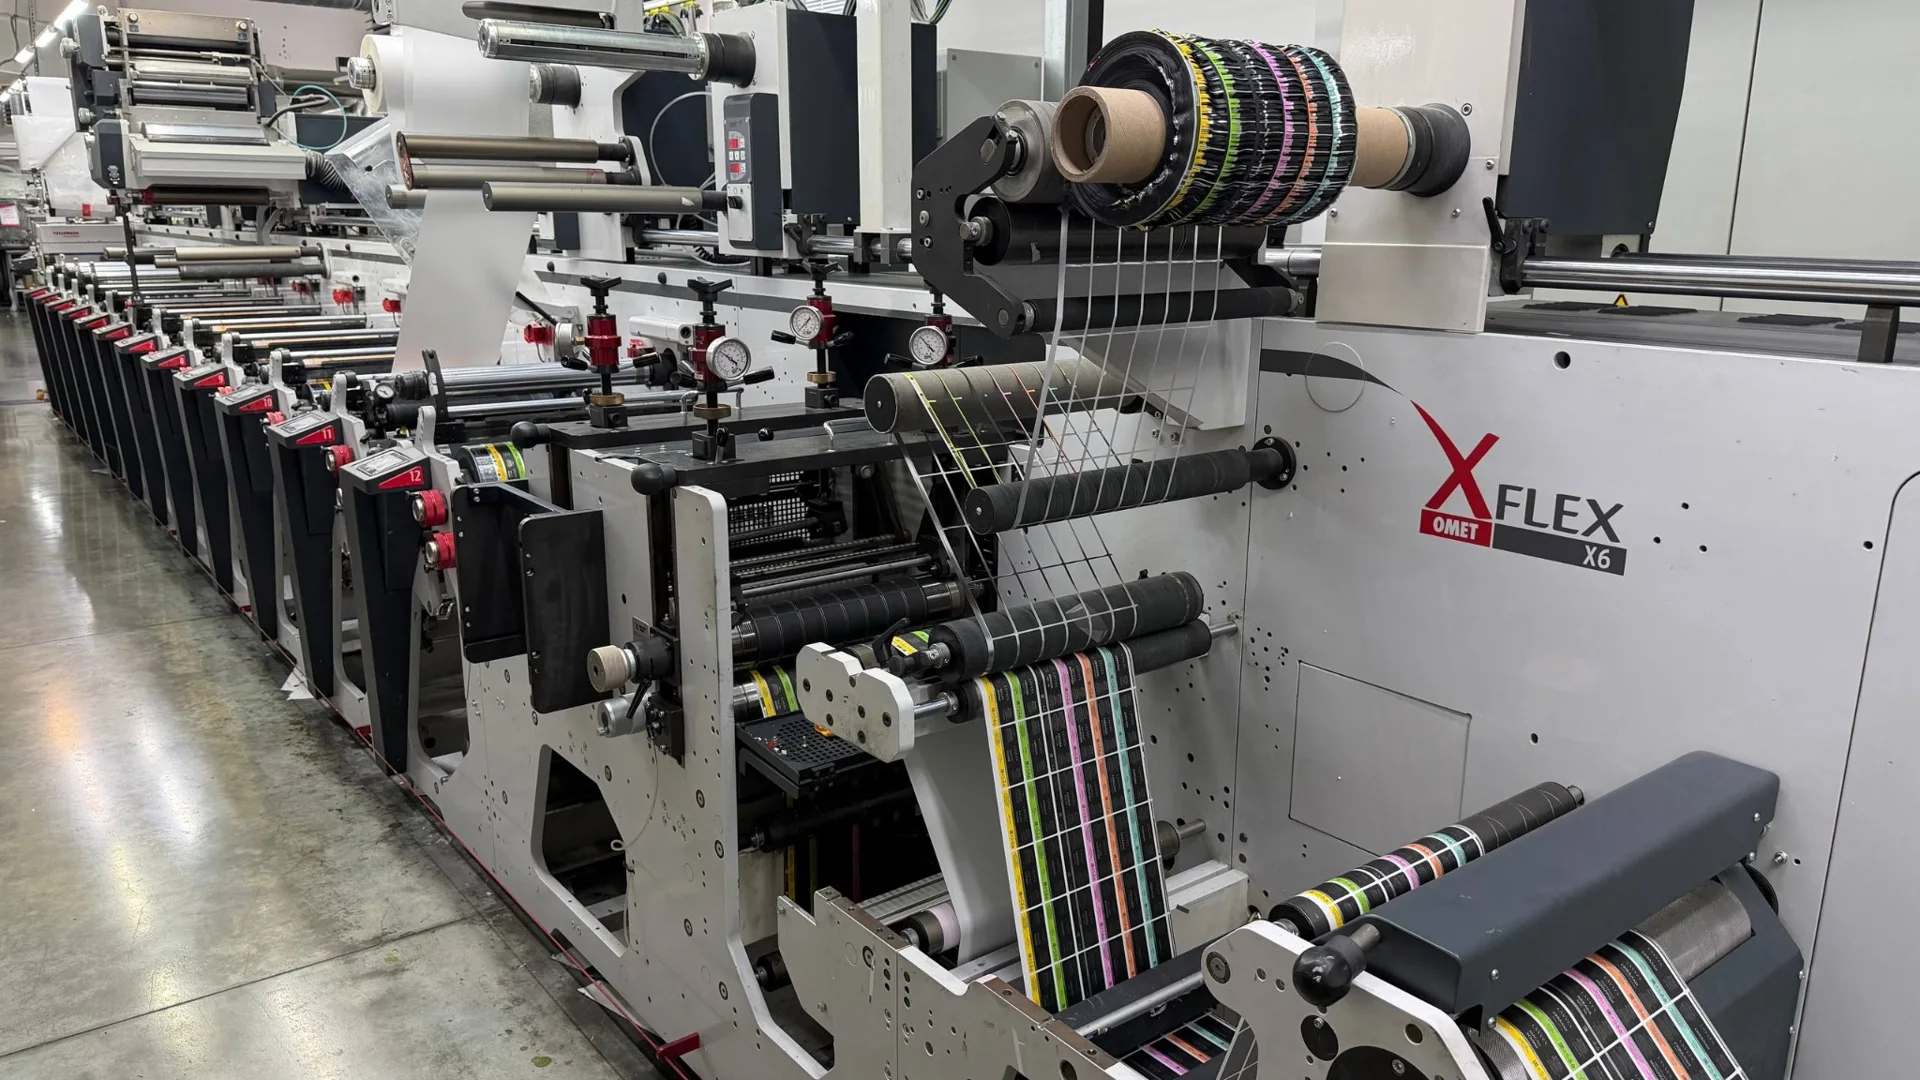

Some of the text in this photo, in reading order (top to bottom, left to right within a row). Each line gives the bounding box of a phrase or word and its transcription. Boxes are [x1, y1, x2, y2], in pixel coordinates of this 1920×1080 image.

[263, 398, 273, 407] 10
[322, 429, 332, 439] 11
[409, 470, 421, 482] 12
[1432, 516, 1479, 540] OMET
[1582, 545, 1611, 569] X6
